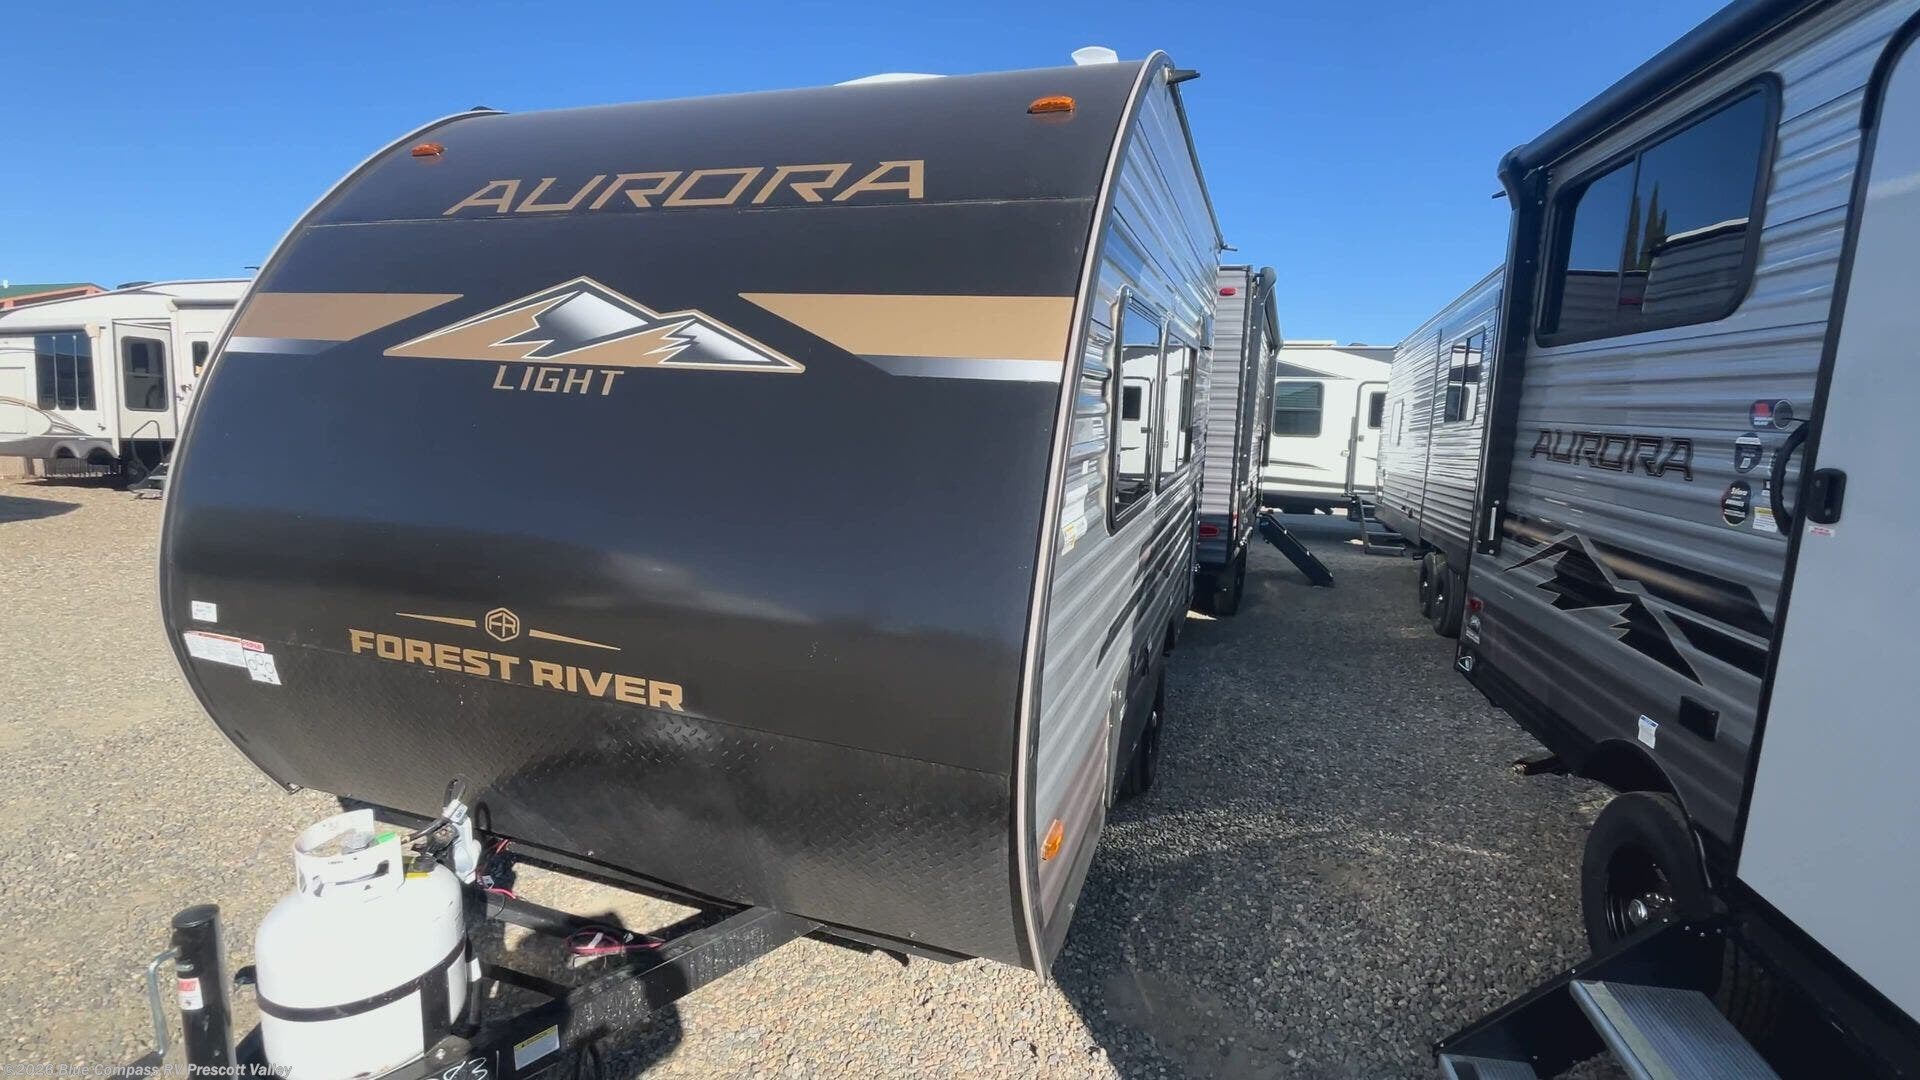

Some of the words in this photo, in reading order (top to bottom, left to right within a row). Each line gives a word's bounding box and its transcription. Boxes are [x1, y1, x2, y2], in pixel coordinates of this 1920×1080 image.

[442, 159, 925, 215] AURORA
[493, 365, 625, 396] LIGHT
[1530, 428, 1694, 482] AURORA
[348, 628, 520, 680] FOREST
[529, 659, 685, 712] RIVER
